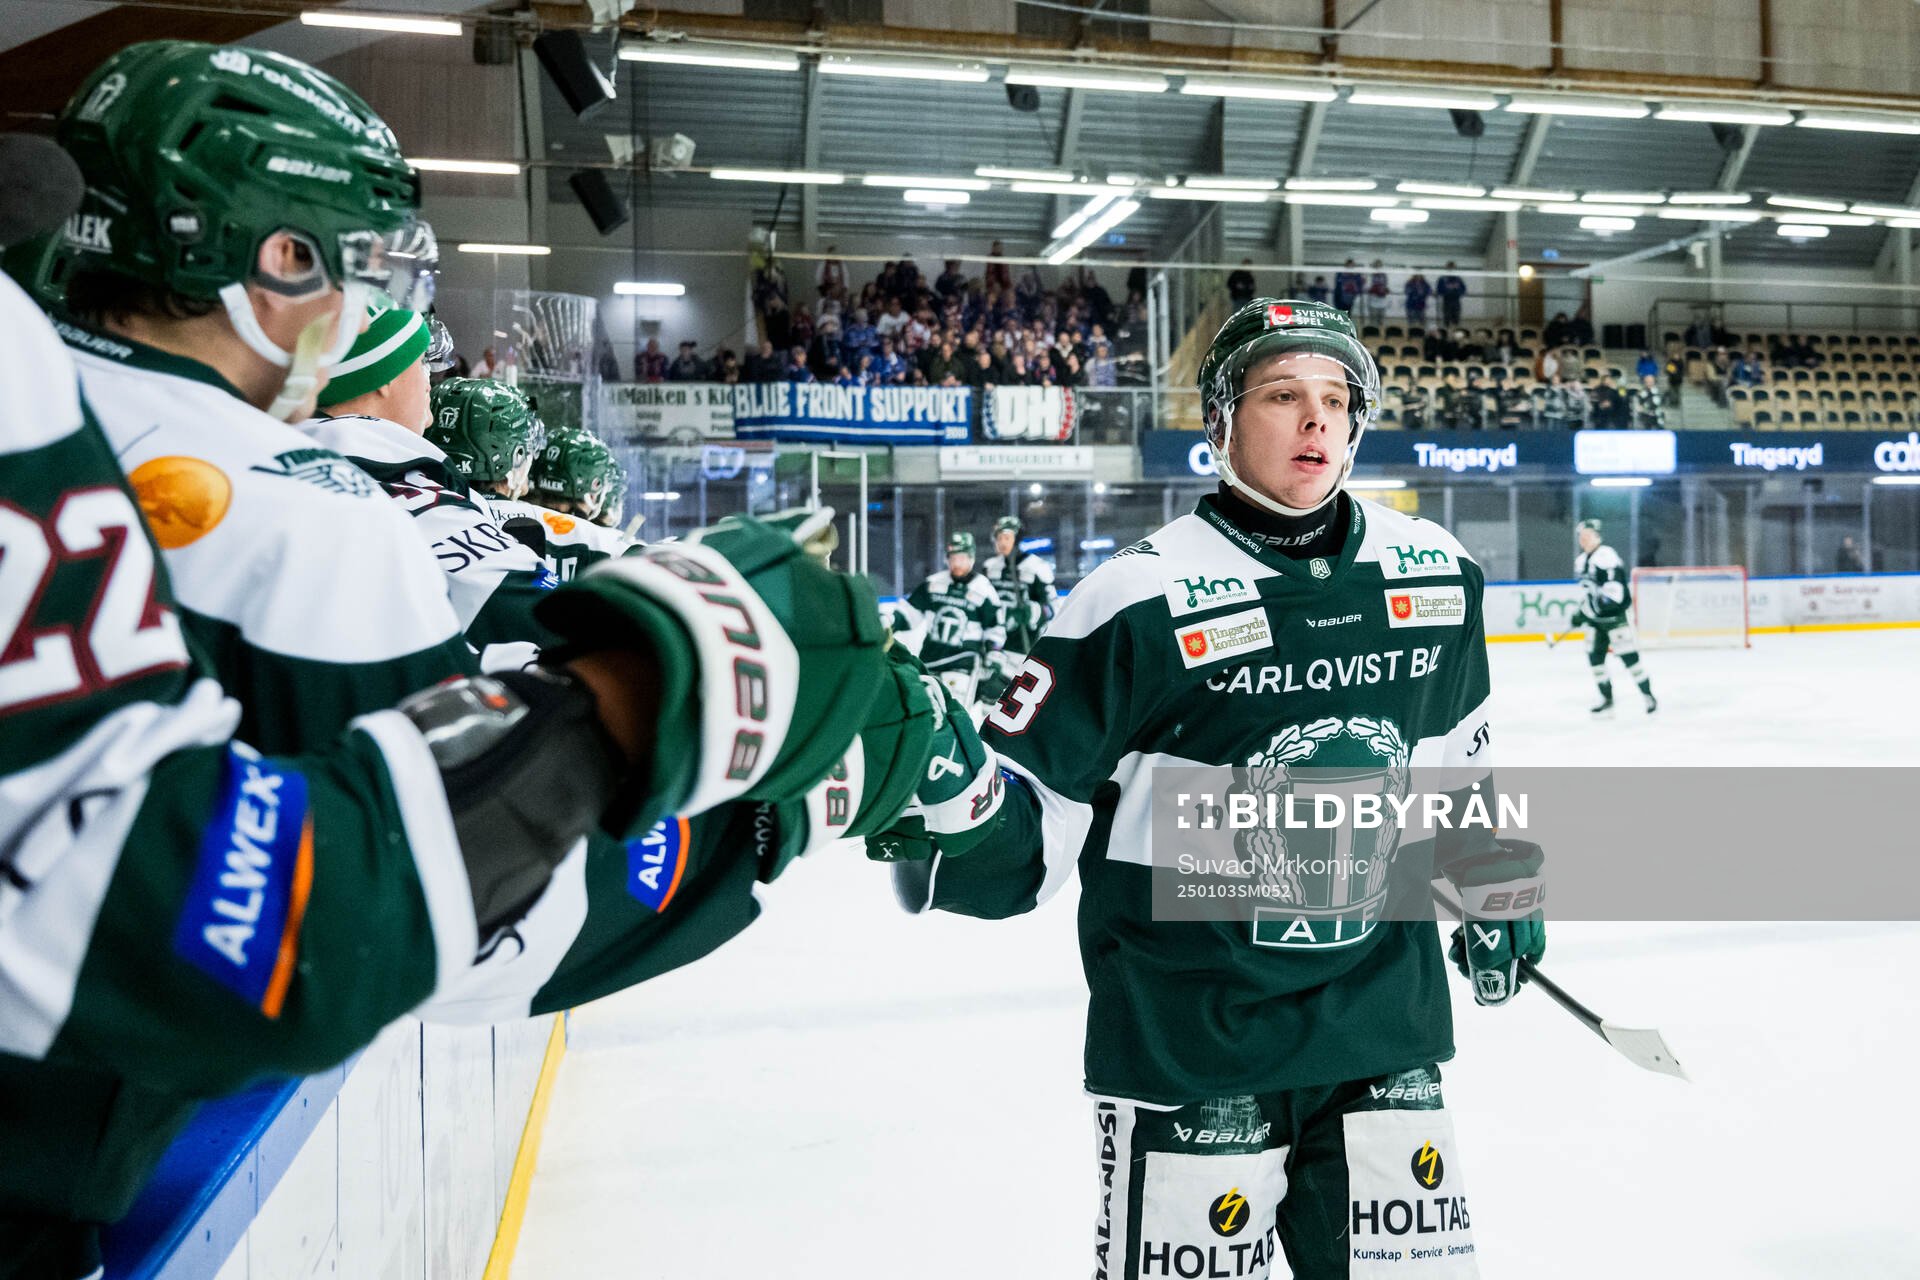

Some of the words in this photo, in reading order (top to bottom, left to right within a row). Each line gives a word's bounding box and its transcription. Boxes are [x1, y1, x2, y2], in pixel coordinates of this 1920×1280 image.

[1295, 309, 1344, 323] SVENSKA
[1296, 317, 1324, 326] SPEL
[735, 382, 790, 418] BLUE
[796, 384, 867, 421] FRONT
[870, 386, 971, 423] SUPPORT
[1413, 443, 1517, 472] Tingsryd
[1729, 442, 1824, 471] Tingsryd
[1216, 591, 1248, 601] workmate
[1412, 594, 1463, 609] Tingsryds
[1318, 614, 1362, 627] BAUER
[1415, 604, 1462, 617] kommun
[1206, 617, 1266, 641] Tingsryds
[1210, 630, 1268, 651] kommun
[1206, 650, 1404, 694] CARLQVIST
[985, 655, 1056, 737] 3
[203, 763, 284, 967] ALWEX
[1195, 1122, 1272, 1145] BAUER
[1352, 1196, 1471, 1236] HOLTAB
[1142, 1226, 1275, 1280] HOLTAB
[1353, 1248, 1402, 1262] Kunskap
[1410, 1246, 1443, 1259] Service
